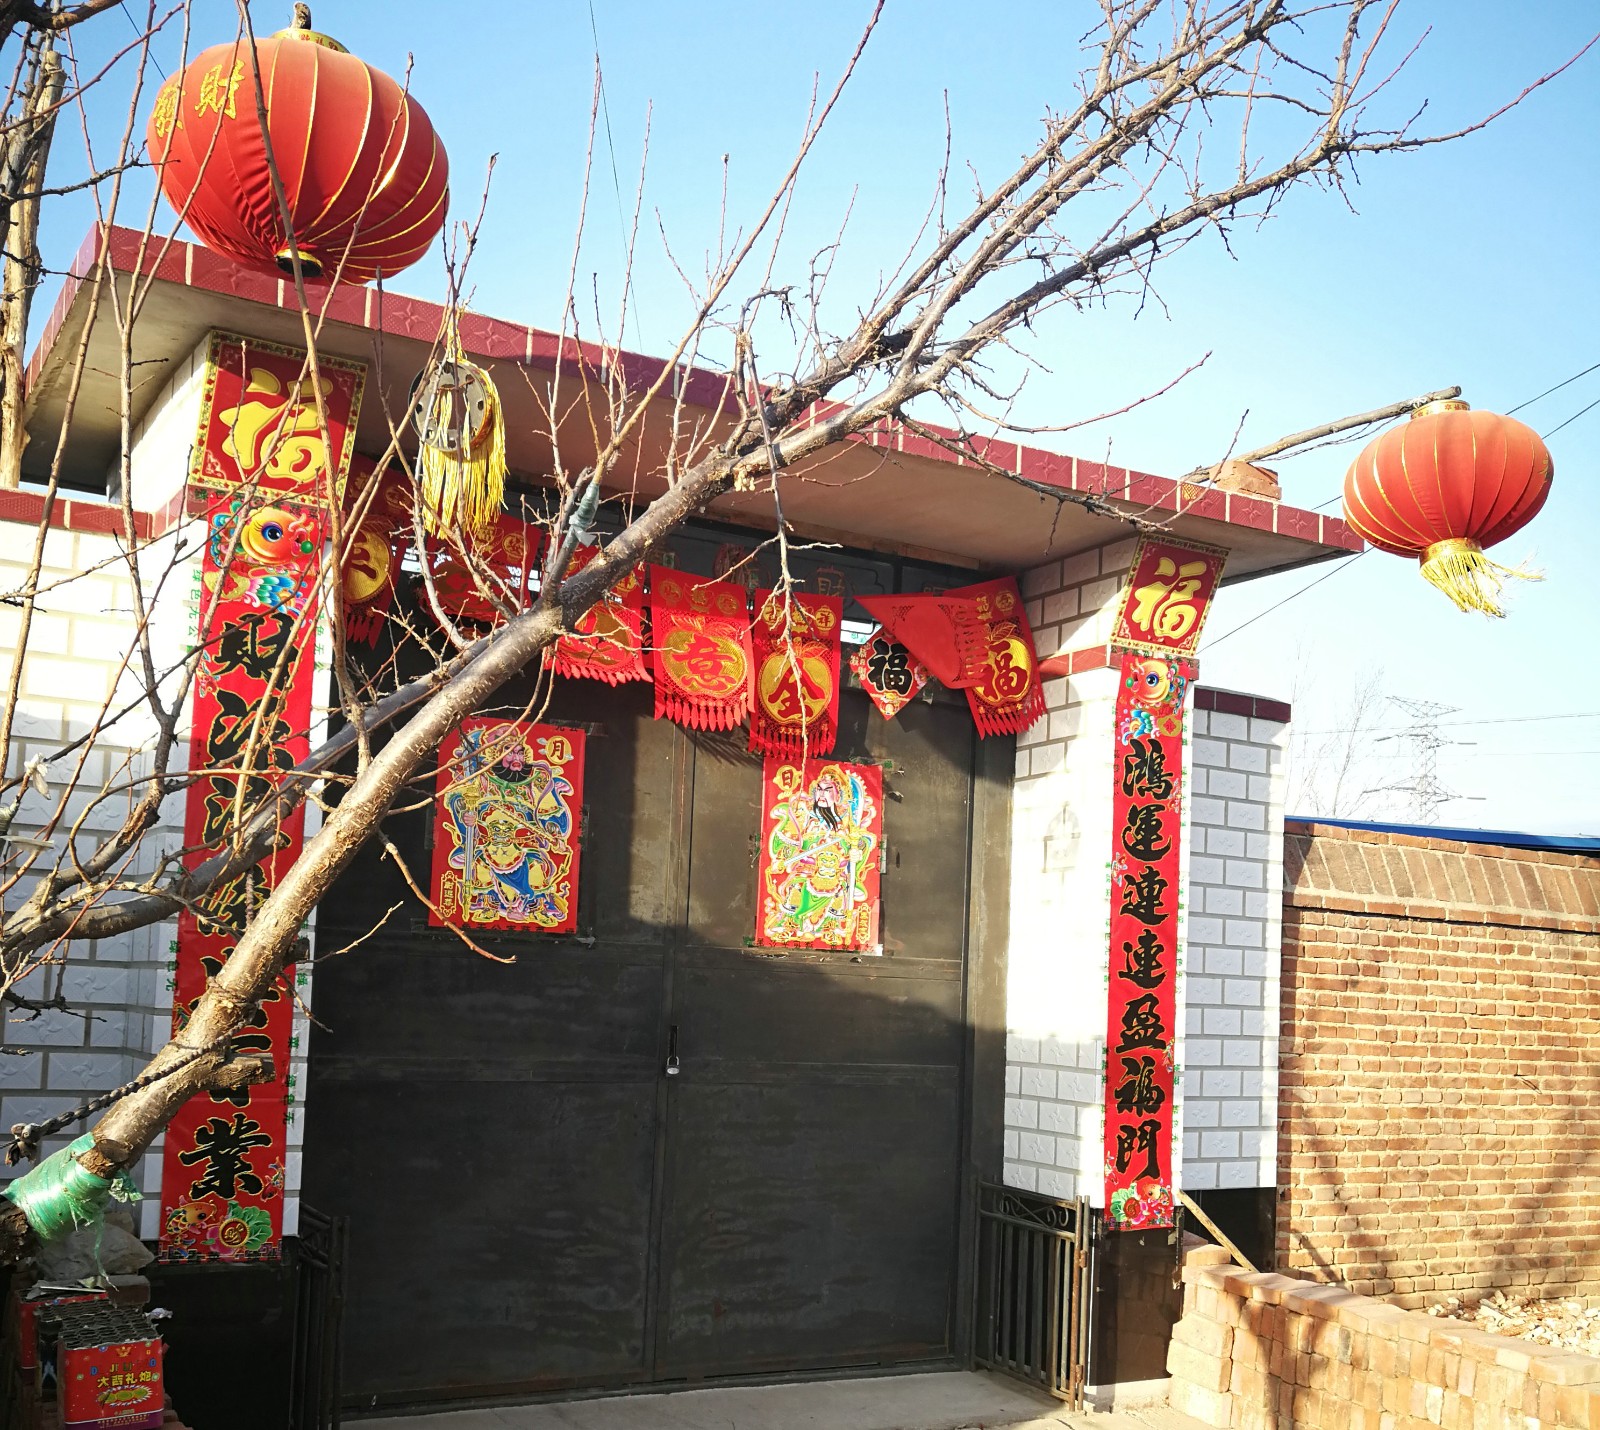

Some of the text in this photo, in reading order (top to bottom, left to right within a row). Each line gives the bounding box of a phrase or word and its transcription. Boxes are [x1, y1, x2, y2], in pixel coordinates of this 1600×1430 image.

[218, 366, 334, 484] 福
[1131, 556, 1208, 640] 福
[768, 657, 826, 720] 金
[867, 637, 915, 697] 福
[979, 640, 1029, 702] 福
[551, 739, 565, 760] 月
